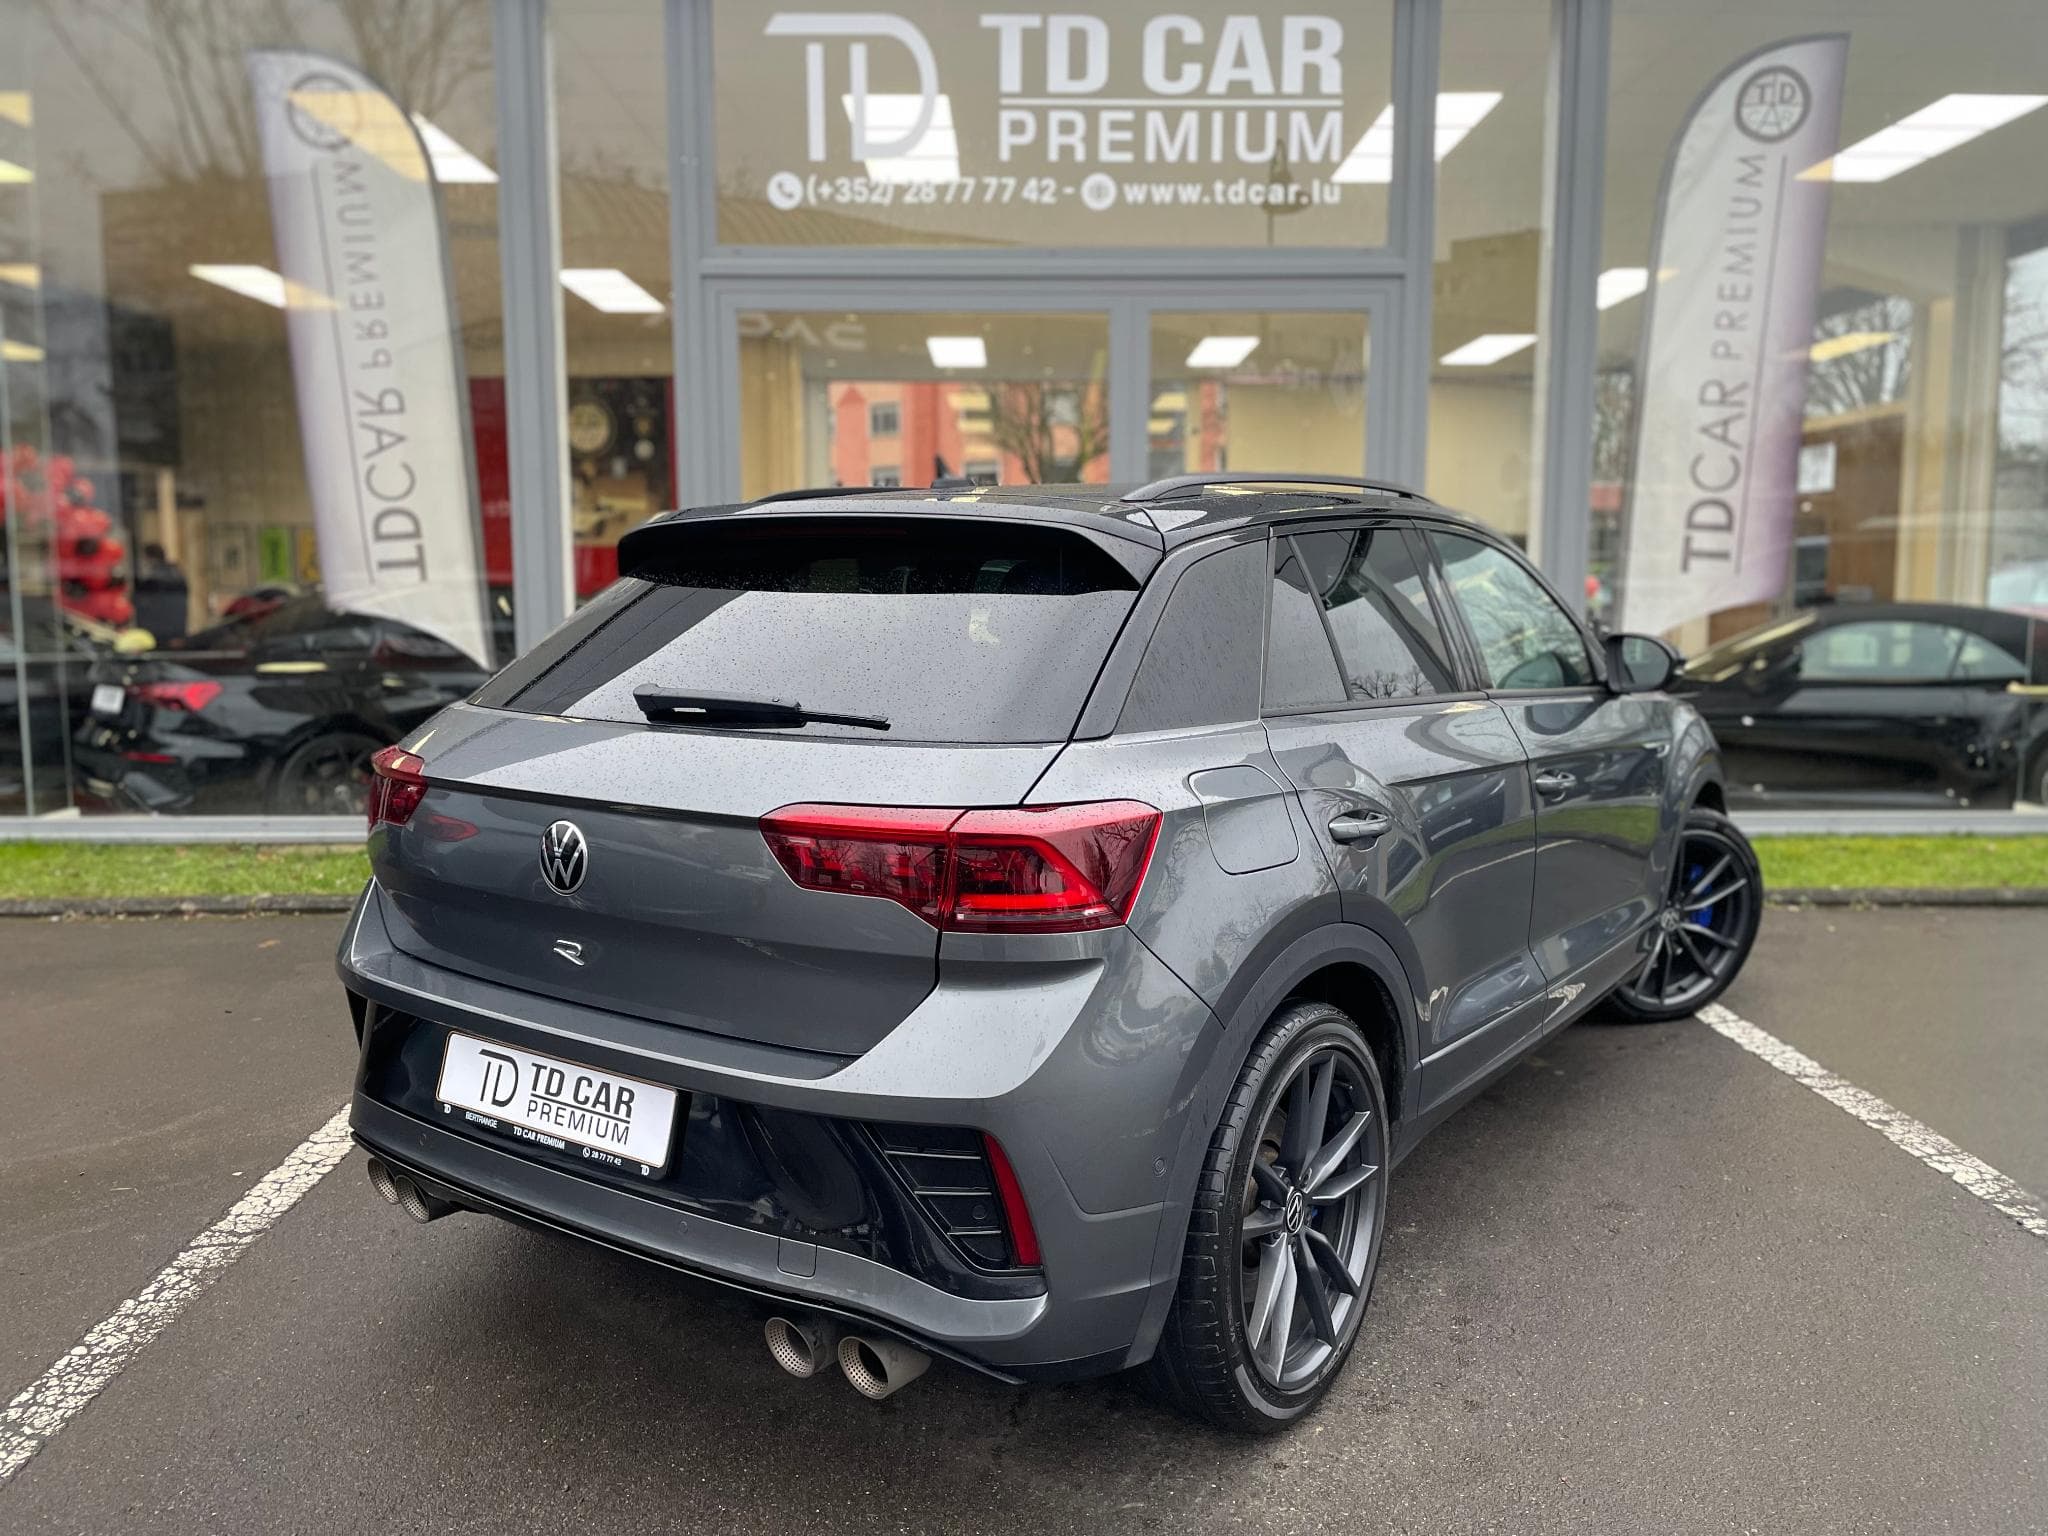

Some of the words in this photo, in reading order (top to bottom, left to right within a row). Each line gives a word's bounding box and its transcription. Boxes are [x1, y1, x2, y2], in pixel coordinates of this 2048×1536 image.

[980, 15, 1110, 94] TD
[1142, 15, 1343, 95] CAR
[1000, 109, 1342, 163] PREMIUM
[902, 177, 938, 205] 28
[944, 177, 977, 205] 77
[982, 176, 1017, 205] 77
[1021, 177, 1058, 205] 42
[1122, 178, 1342, 205] www.tdcar.lu
[1710, 152, 1767, 361] PREMIUM
[1681, 379, 1750, 575] TDCAR
[530, 1062, 565, 1098] TD
[572, 1075, 635, 1119] CAR
[465, 1111, 499, 1129] BERTRANGE
[513, 1125, 522, 1136] TD
[522, 1129, 536, 1141] CAR
[536, 1133, 566, 1150] PREMIUM
[526, 1099, 630, 1146] PREMIUM
